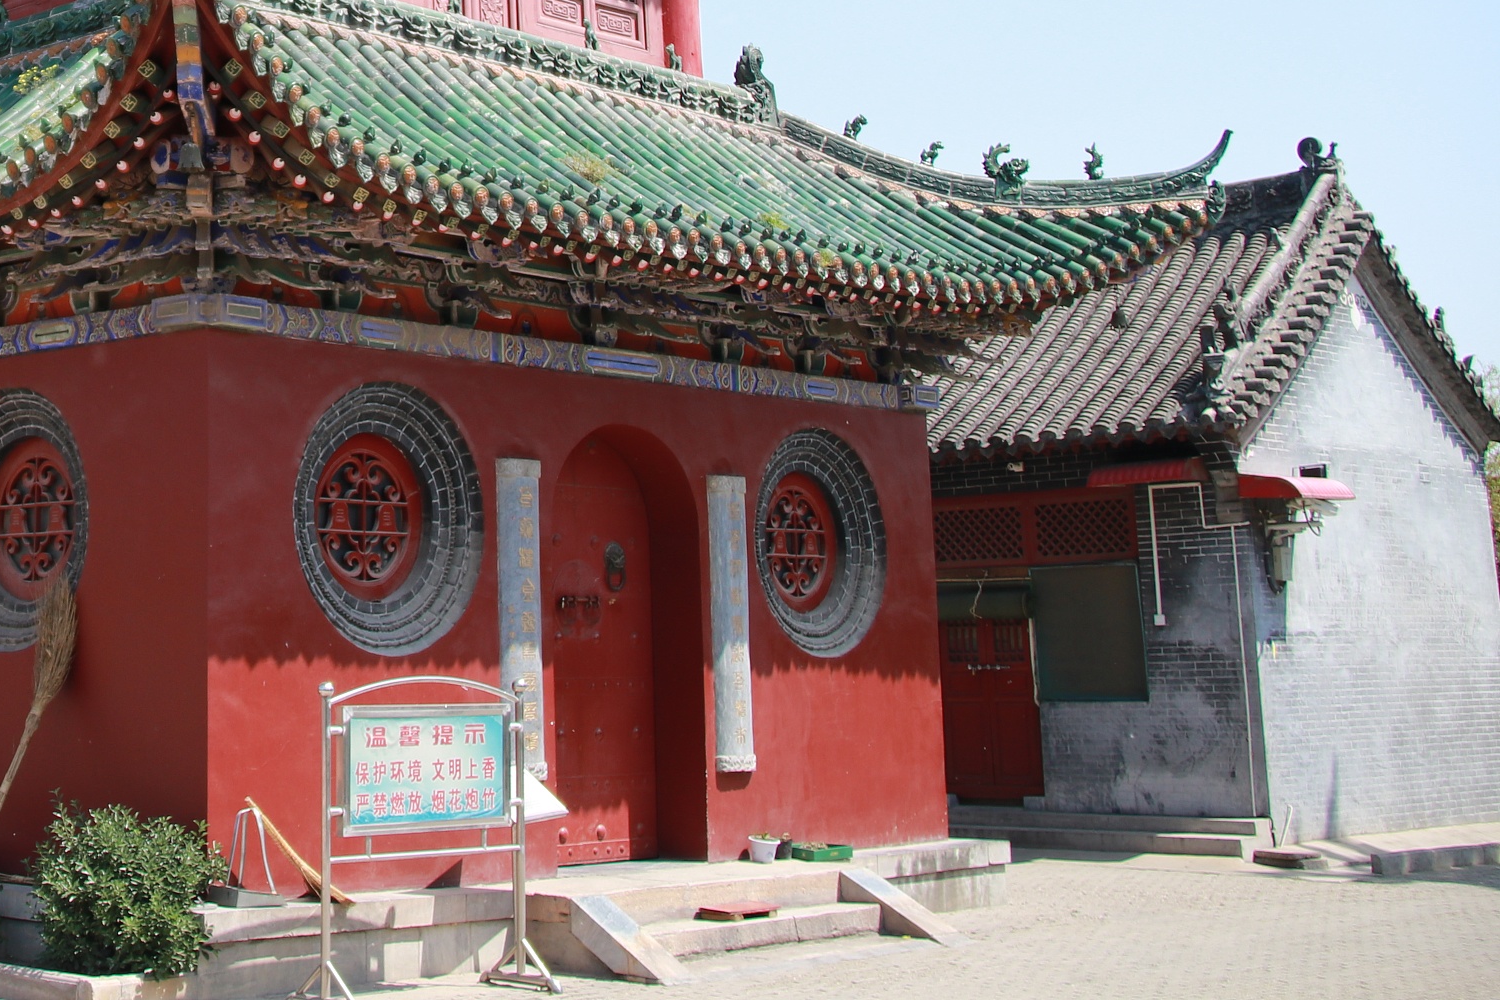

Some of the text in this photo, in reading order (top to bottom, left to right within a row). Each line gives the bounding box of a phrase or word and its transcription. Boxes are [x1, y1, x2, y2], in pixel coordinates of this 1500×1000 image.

[365, 723, 485, 748] 温馨提示
[355, 757, 496, 785] 保护环境 文明上香
[355, 787, 496, 817] 严禁燃放 烟花炮竹
